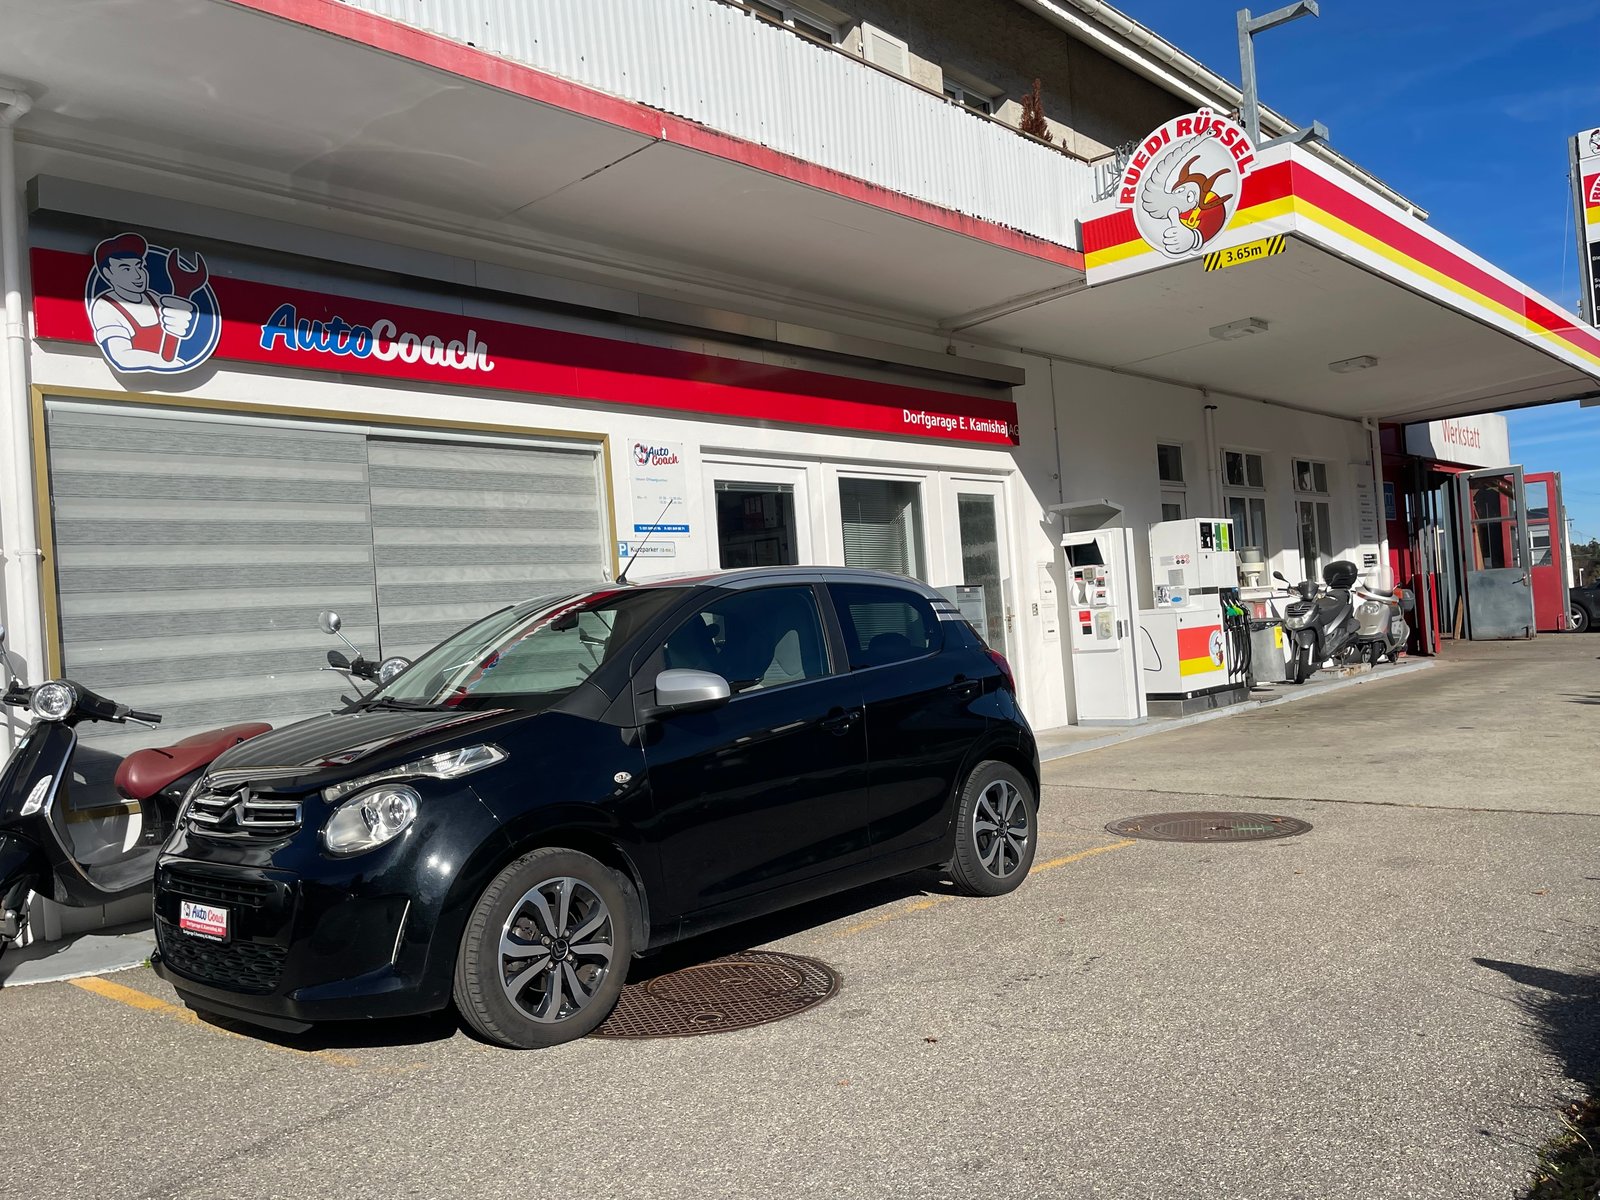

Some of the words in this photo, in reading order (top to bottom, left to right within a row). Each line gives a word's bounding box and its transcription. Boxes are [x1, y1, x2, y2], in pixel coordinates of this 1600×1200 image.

[1120, 127, 1171, 204] RUEDI
[1176, 110, 1255, 175] RÜSSEL
[1226, 244, 1262, 263] 3.65m
[903, 409, 957, 431] Dorfgarage
[959, 416, 968, 430] E.
[969, 418, 1009, 438] Kamishaj
[1441, 419, 1480, 448] Werkstatt
[648, 446, 669, 457] Auto
[652, 454, 679, 466] Coach
[192, 905, 207, 921] Auto
